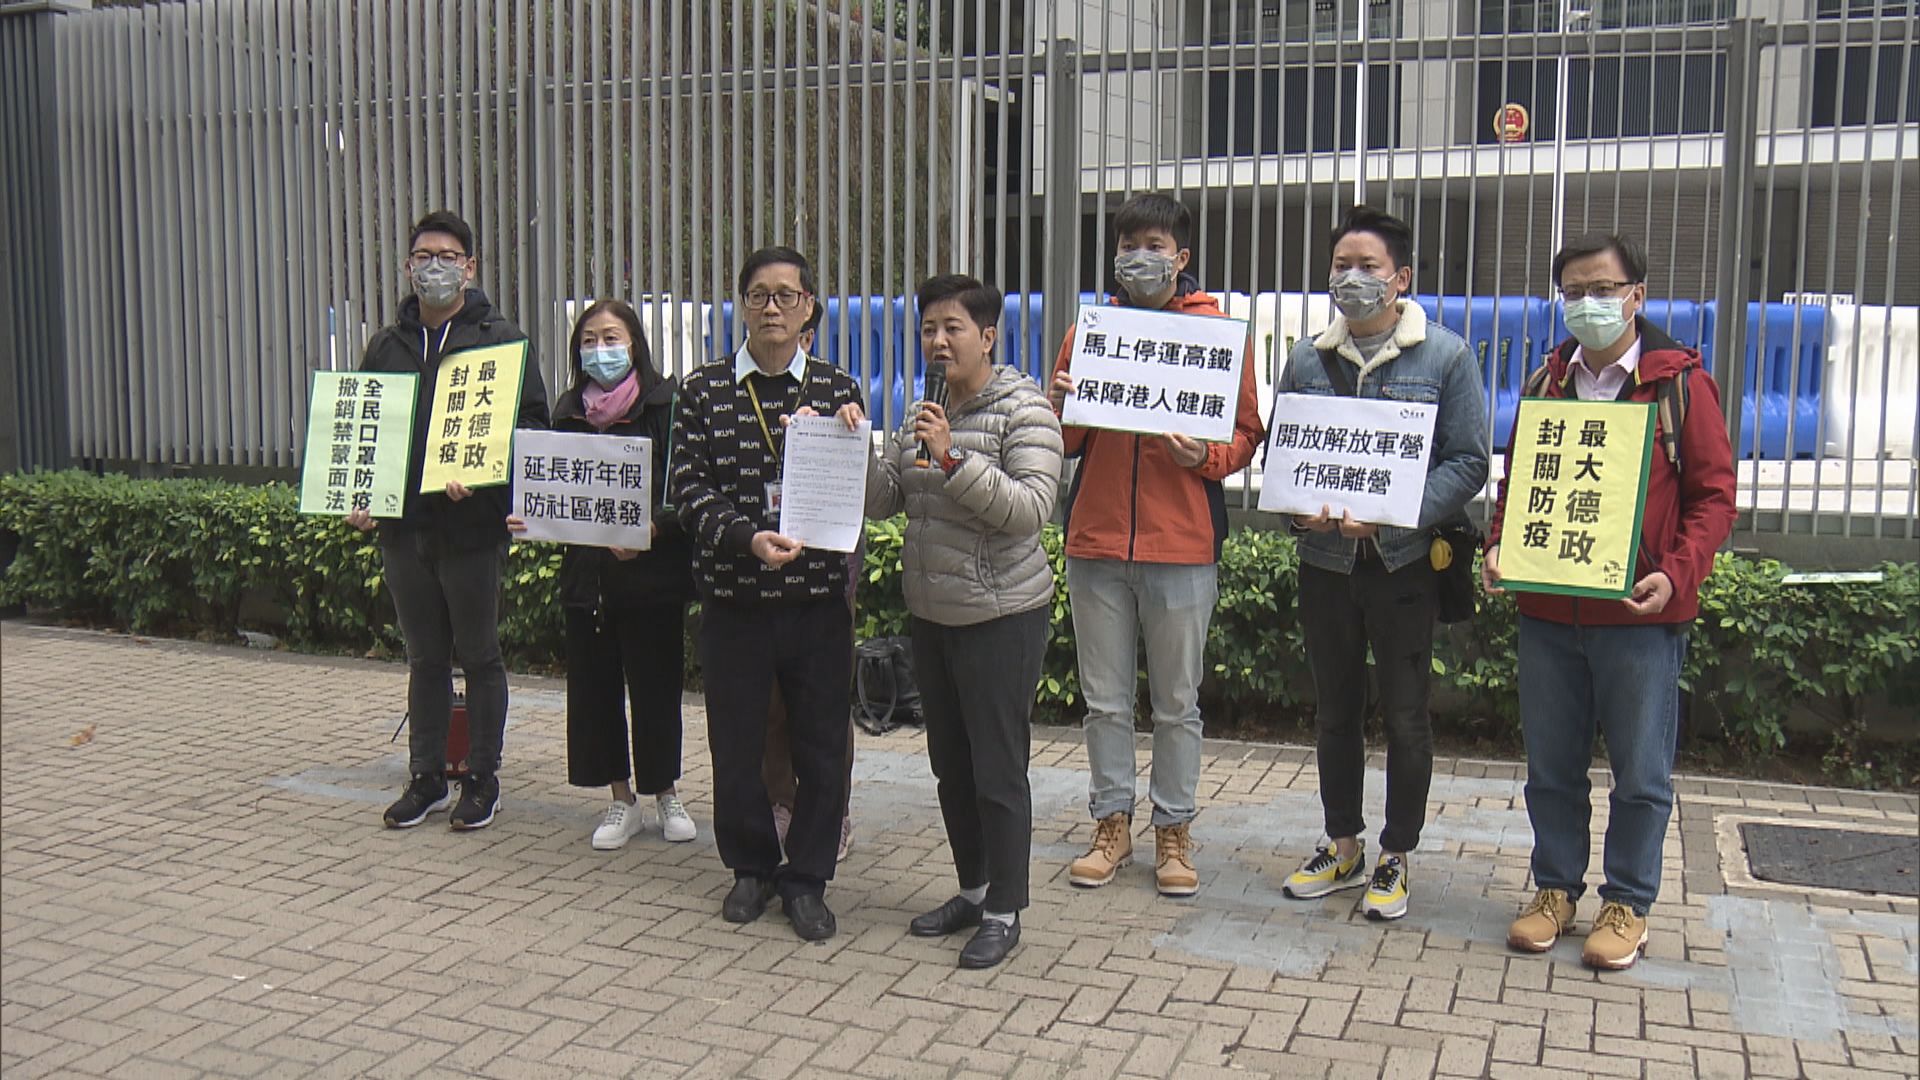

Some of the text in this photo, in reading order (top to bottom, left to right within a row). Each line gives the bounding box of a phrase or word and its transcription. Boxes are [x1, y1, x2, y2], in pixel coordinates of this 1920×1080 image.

[1082, 332, 1233, 372] 馬上停運高鐵
[709, 380, 730, 388] BKLYN
[1076, 378, 1226, 419] 保障港人健康
[439, 364, 470, 464] 封關防疫
[463, 360, 497, 469] 最大德政
[712, 404, 734, 413] BKLYN
[762, 401, 784, 409] BKLYN
[325, 376, 359, 511] 撤銷禁蒙面法
[351, 378, 384, 512] 全民口罩防疫
[713, 428, 736, 437] BKLYN
[739, 441, 760, 449] BKLYN
[1275, 424, 1425, 461] 開放解放軍營
[523, 455, 643, 490] 延長新年假
[716, 456, 737, 465] BKLYN
[739, 468, 760, 477] BKLYN
[1293, 461, 1393, 496] 作隔離營
[739, 496, 760, 504] BKLYN
[1523, 418, 1567, 550] 封關防疫
[1558, 419, 1609, 566] 最大德政
[523, 491, 643, 528] 防社區爆發
